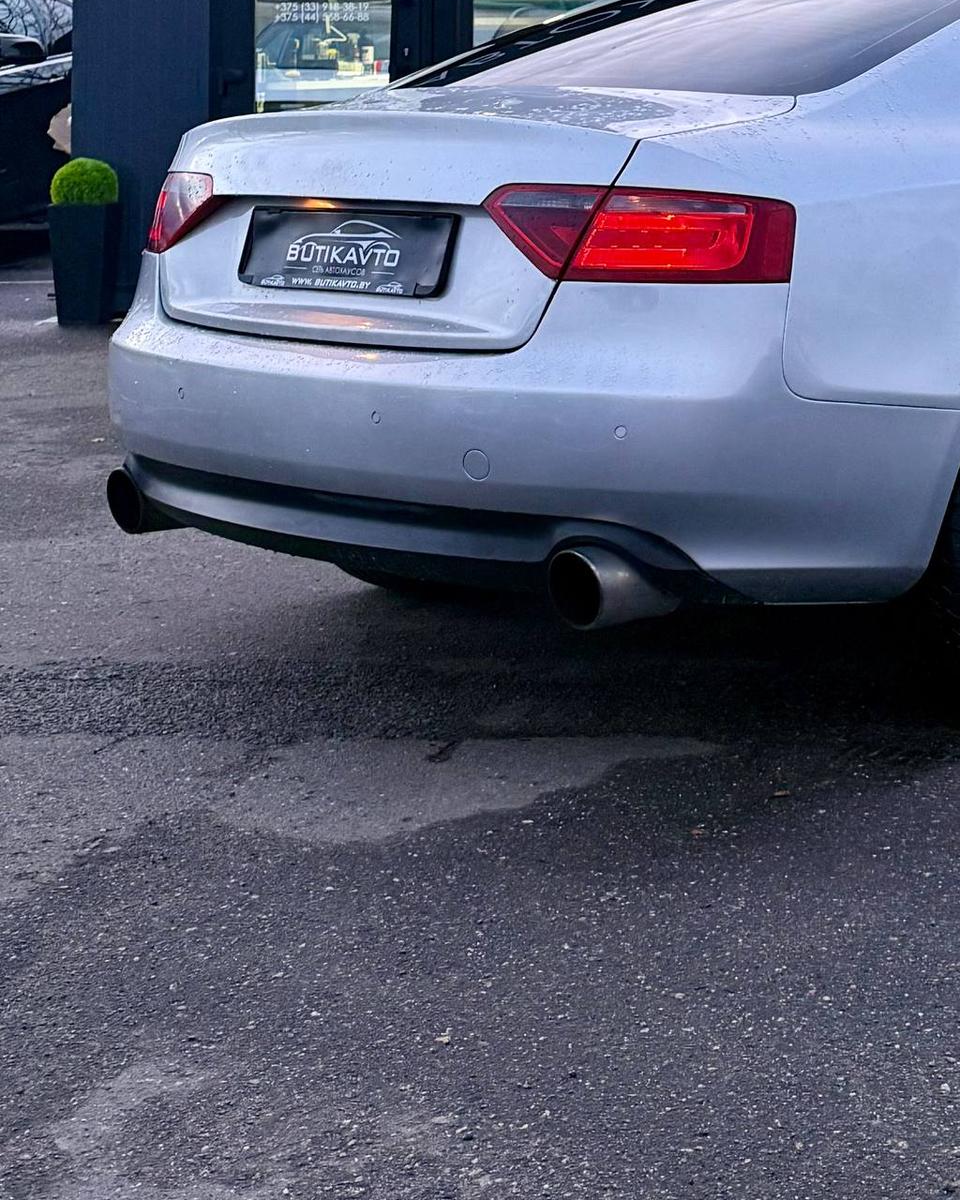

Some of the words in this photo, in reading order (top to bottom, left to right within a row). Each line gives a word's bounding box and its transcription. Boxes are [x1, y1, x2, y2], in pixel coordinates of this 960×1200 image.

[275, 2, 298, 12] +375
[301, 2, 319, 14] (33)
[322, 2, 369, 12] 918-38-19
[275, 12, 298, 22] +375
[301, 12, 319, 23] (44)
[286, 244, 400, 267] BUTIKAVTO
[314, 278, 371, 290] BUTIKAVTO.BY
